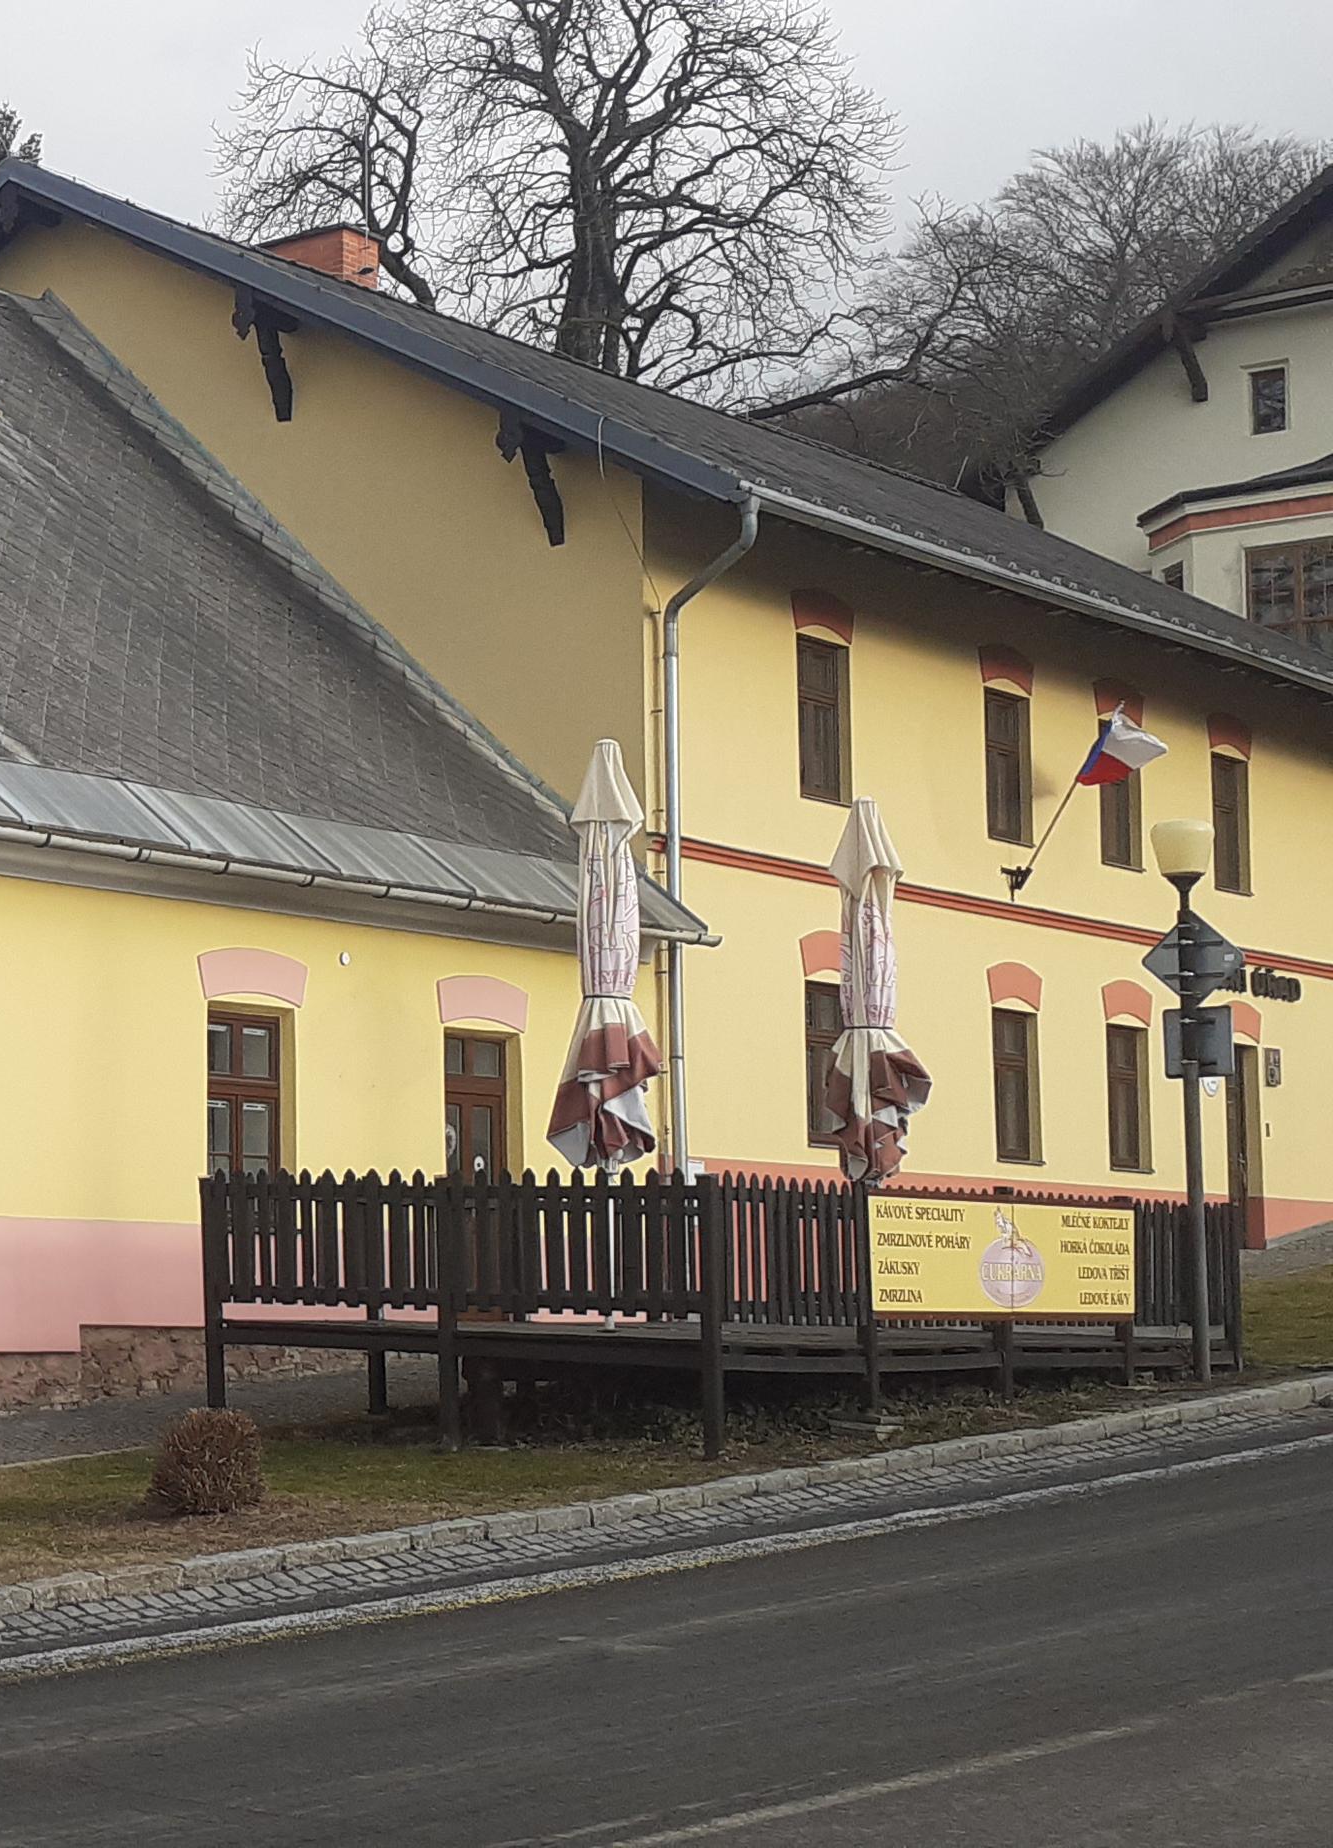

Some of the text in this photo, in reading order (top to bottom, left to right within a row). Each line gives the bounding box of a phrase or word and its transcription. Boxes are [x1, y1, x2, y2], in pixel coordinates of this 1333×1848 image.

[876, 1201, 965, 1222] KÁVOVÉ SPECIALITY
[877, 1231, 971, 1249] ZMRZLINOVÉ POHÁRY
[1089, 1238, 1130, 1255] ČOKOLÁDA
[878, 1258, 920, 1275] ZÁKUSKY
[982, 1258, 1042, 1281] CUKRÁRNA
[879, 1288, 923, 1303] ZMRZLINA
[1110, 1289, 1131, 1305] KÁVY
